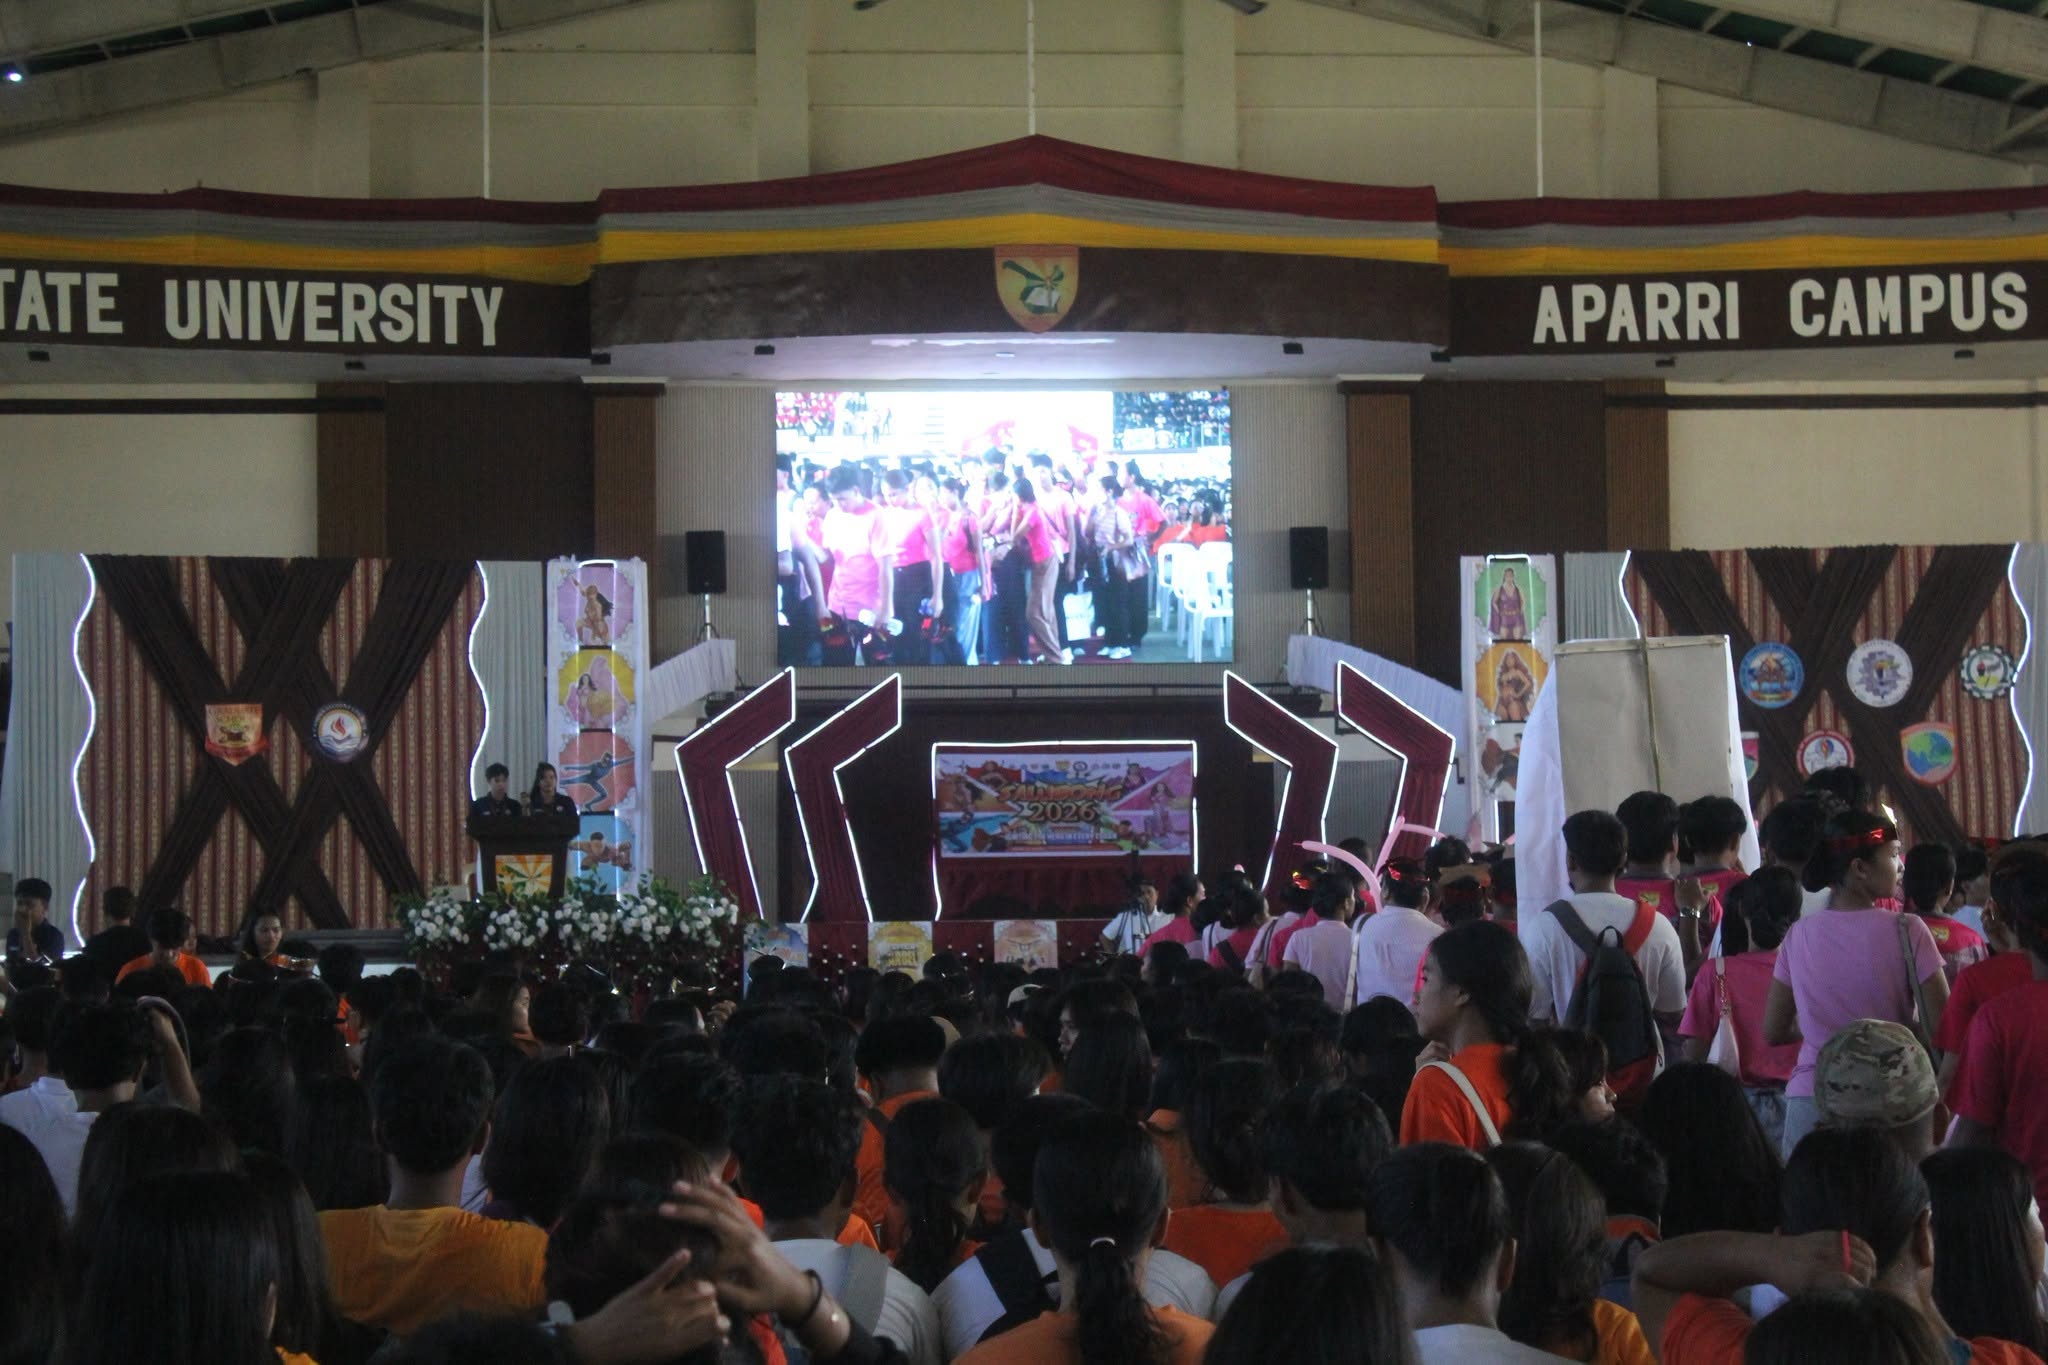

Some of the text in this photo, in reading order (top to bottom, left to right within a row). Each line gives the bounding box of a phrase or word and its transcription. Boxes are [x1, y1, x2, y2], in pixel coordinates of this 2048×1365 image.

[165, 279, 503, 346] UNIVERSITY
[1533, 272, 2028, 344] APARRI CAMPUS
[1030, 802, 1096, 821] 2026
